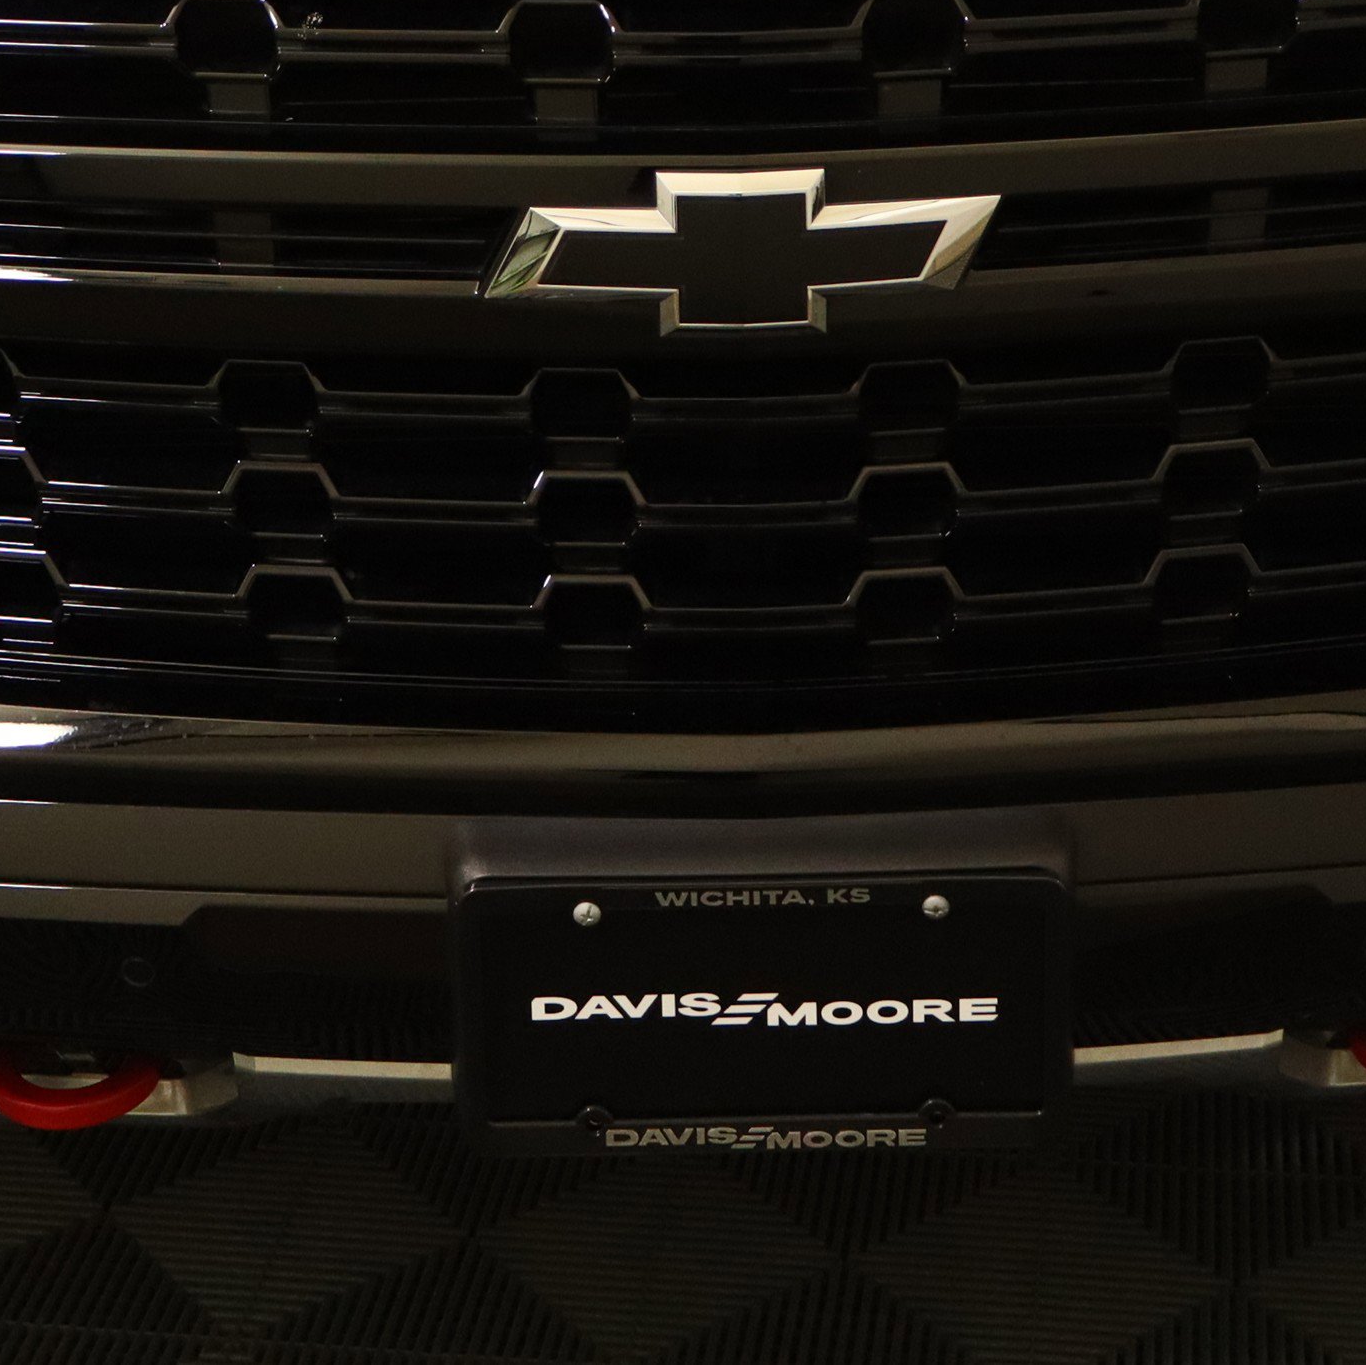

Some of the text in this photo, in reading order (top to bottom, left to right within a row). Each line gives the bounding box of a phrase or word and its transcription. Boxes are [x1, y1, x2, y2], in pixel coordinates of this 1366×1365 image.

[827, 887, 871, 905] KS
[531, 992, 998, 1027] DAVIS MOORE
[605, 1126, 927, 1150] DAVIS MOORE
